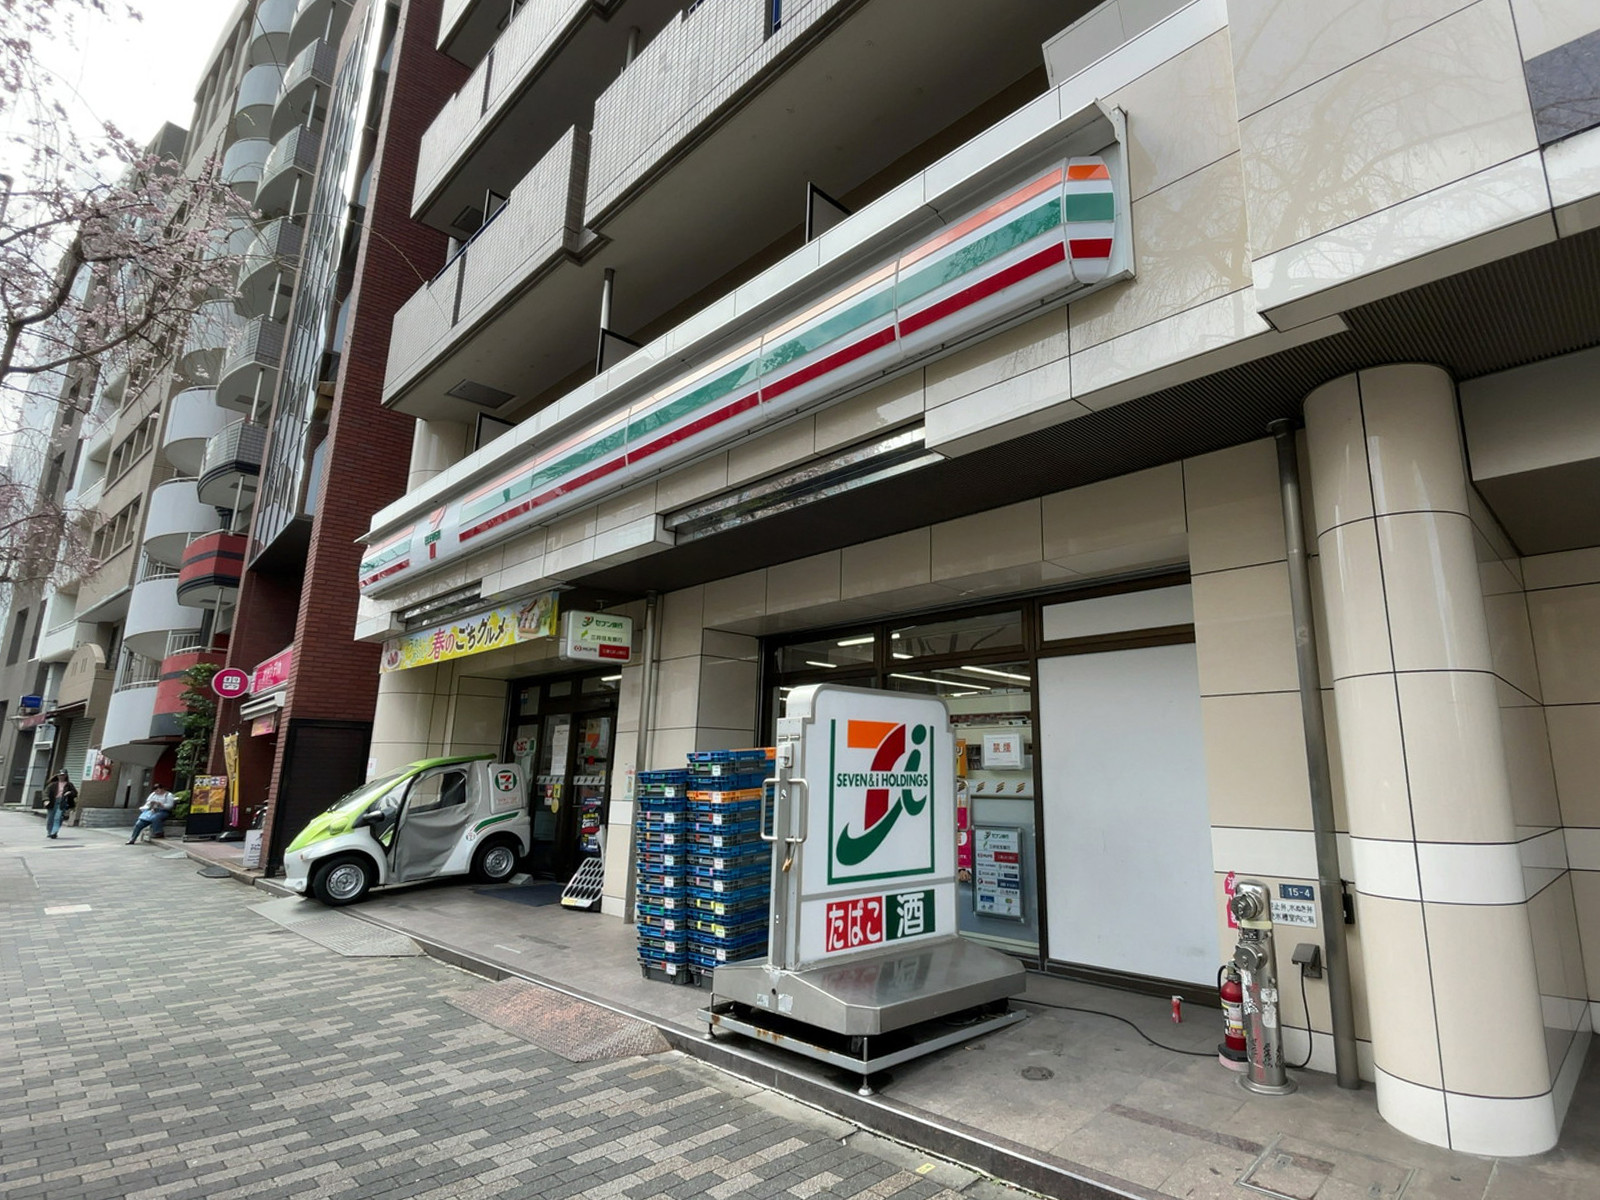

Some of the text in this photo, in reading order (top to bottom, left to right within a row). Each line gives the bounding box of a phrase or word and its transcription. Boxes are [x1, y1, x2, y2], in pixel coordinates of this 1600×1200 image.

[427, 616, 506, 660] 春のごちグルメ
[836, 772, 929, 788] SEVEN&i HOLDINGS
[1287, 887, 1311, 898] 15-4
[828, 899, 881, 950] たばこ
[896, 892, 925, 938] 酒
